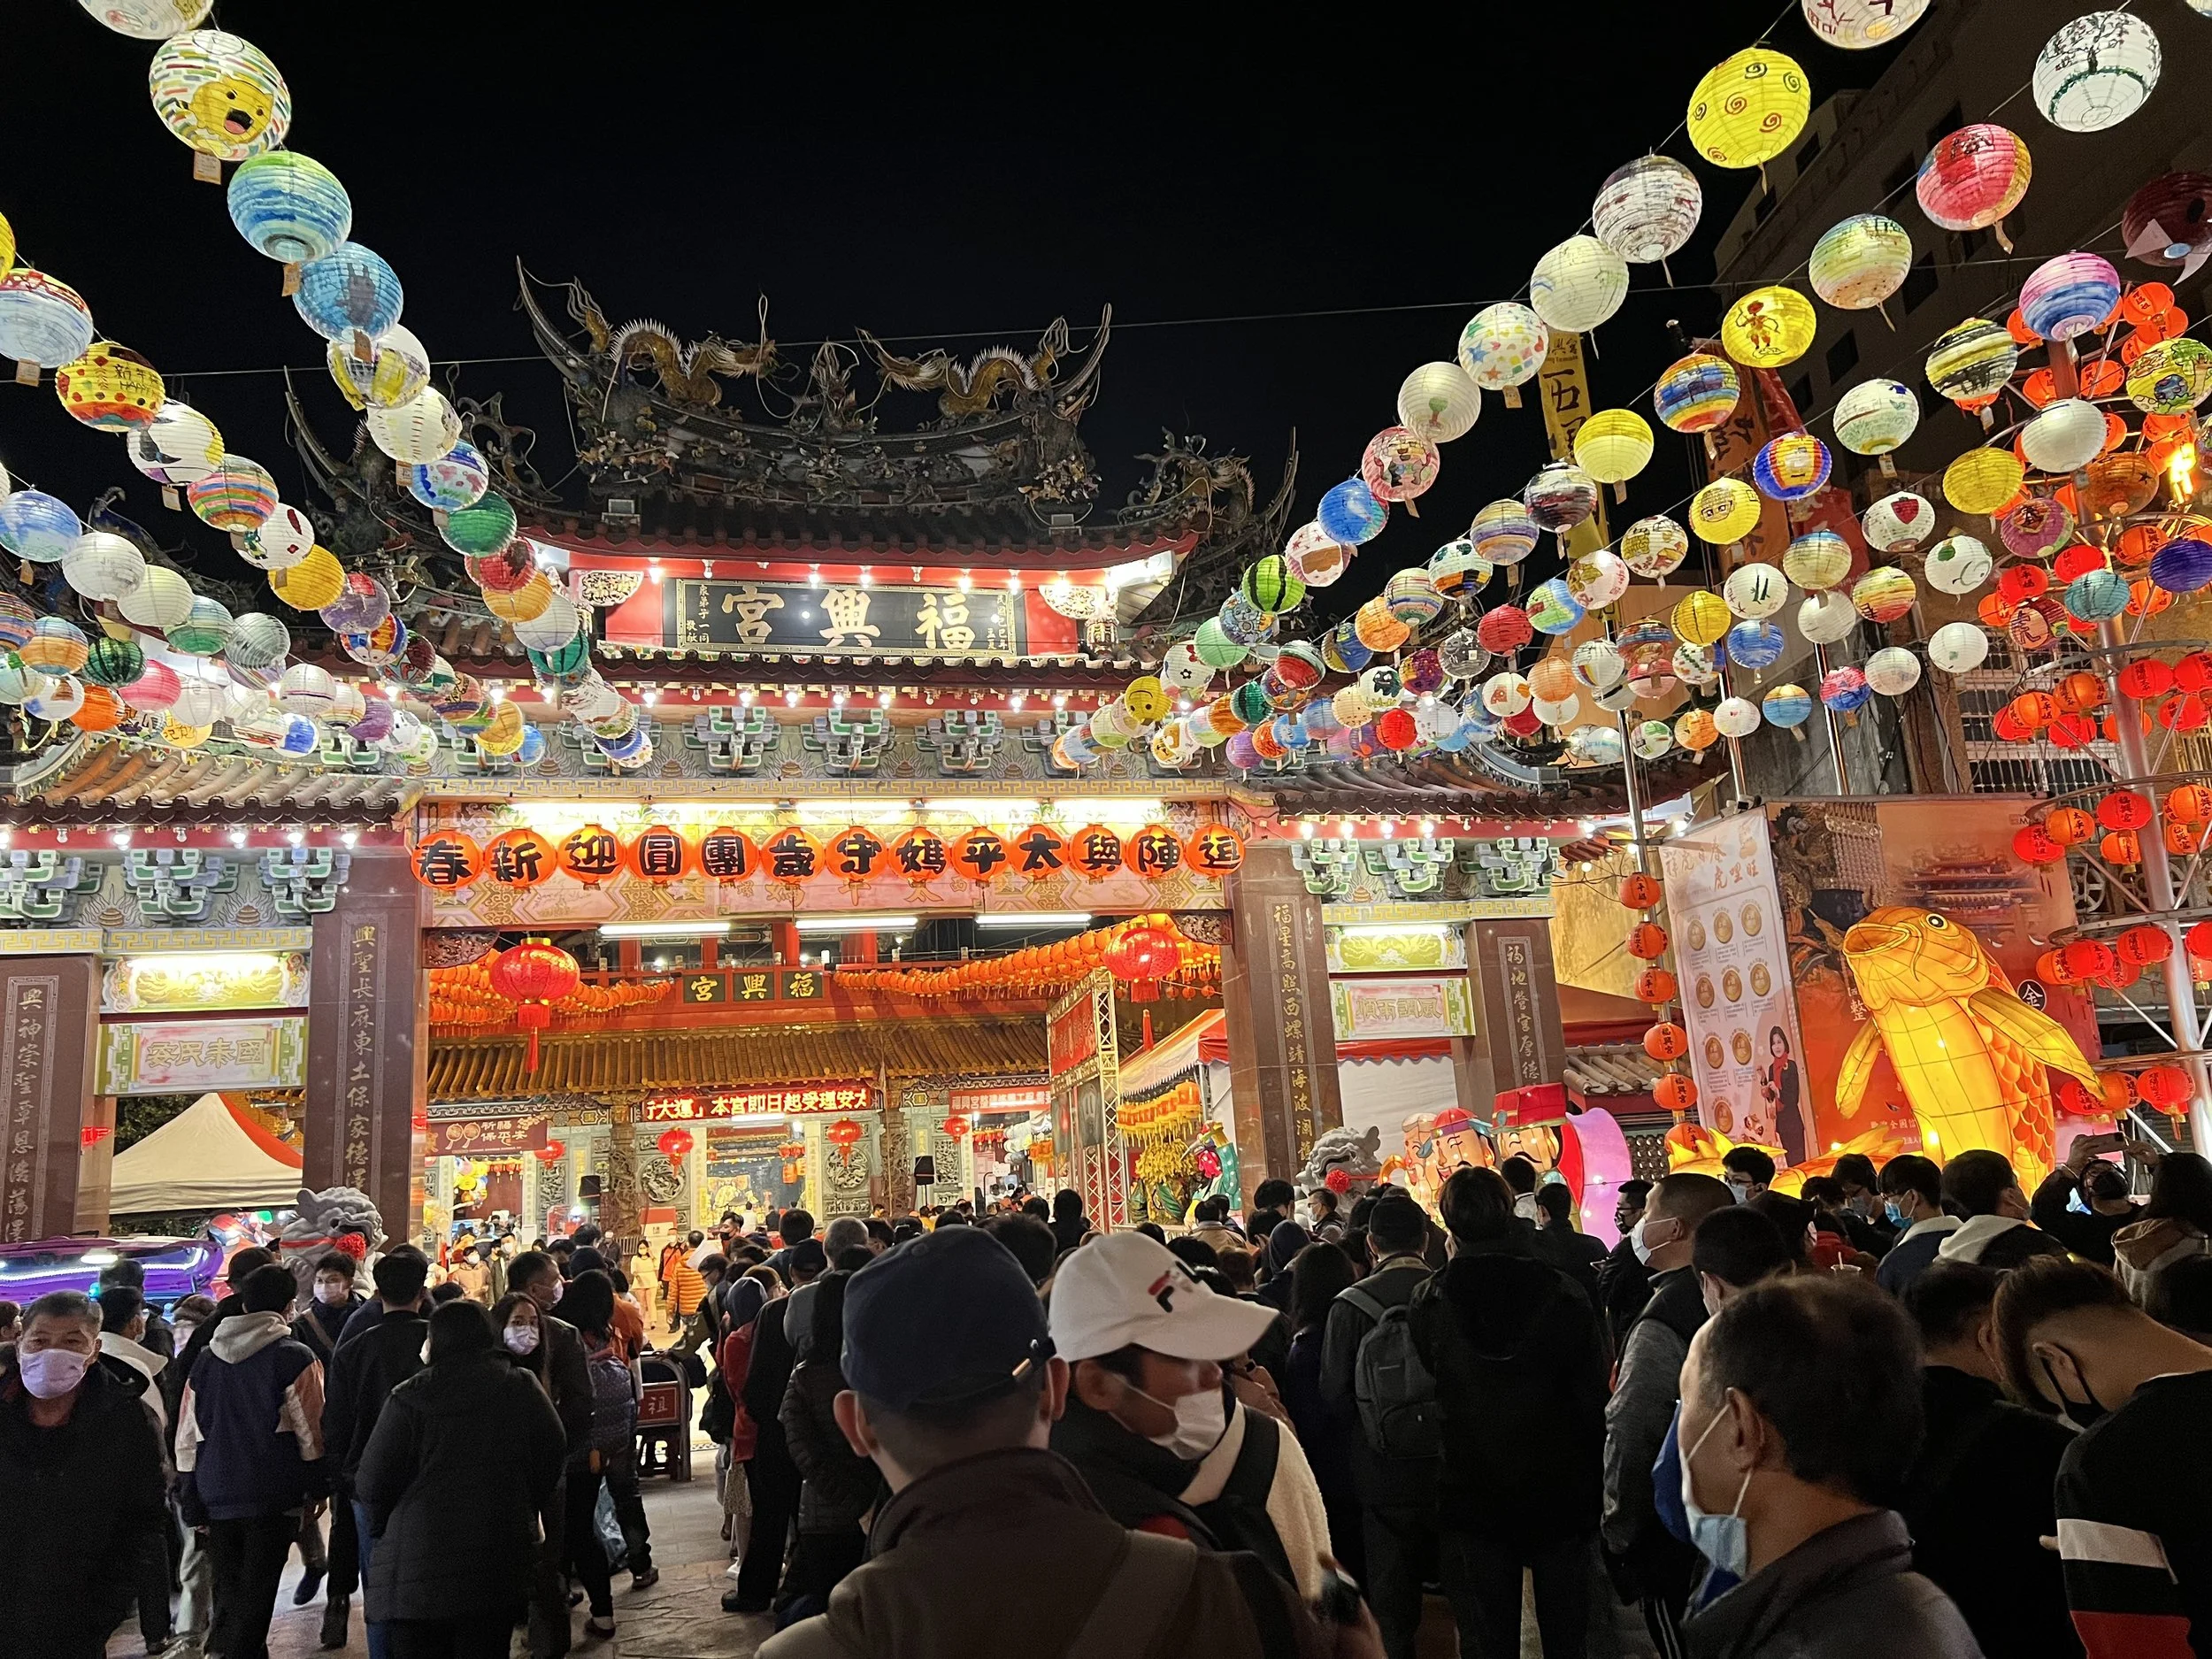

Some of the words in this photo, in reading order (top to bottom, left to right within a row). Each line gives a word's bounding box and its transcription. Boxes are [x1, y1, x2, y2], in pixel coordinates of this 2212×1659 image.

[722, 585, 976, 650] 福興宮
[2040, 695, 2053, 720] 太平媽
[2073, 811, 2085, 839] 太平媽
[690, 972, 815, 1002] 福興宮
[2022, 983, 2043, 1006] 金
[1356, 997, 1443, 1023] 風調雨順
[1850, 999, 1867, 1022] 整
[146, 1037, 265, 1069] 國泰民安
[1661, 1027, 1673, 1056] 福興宮
[648, 1396, 668, 1415] 祖
